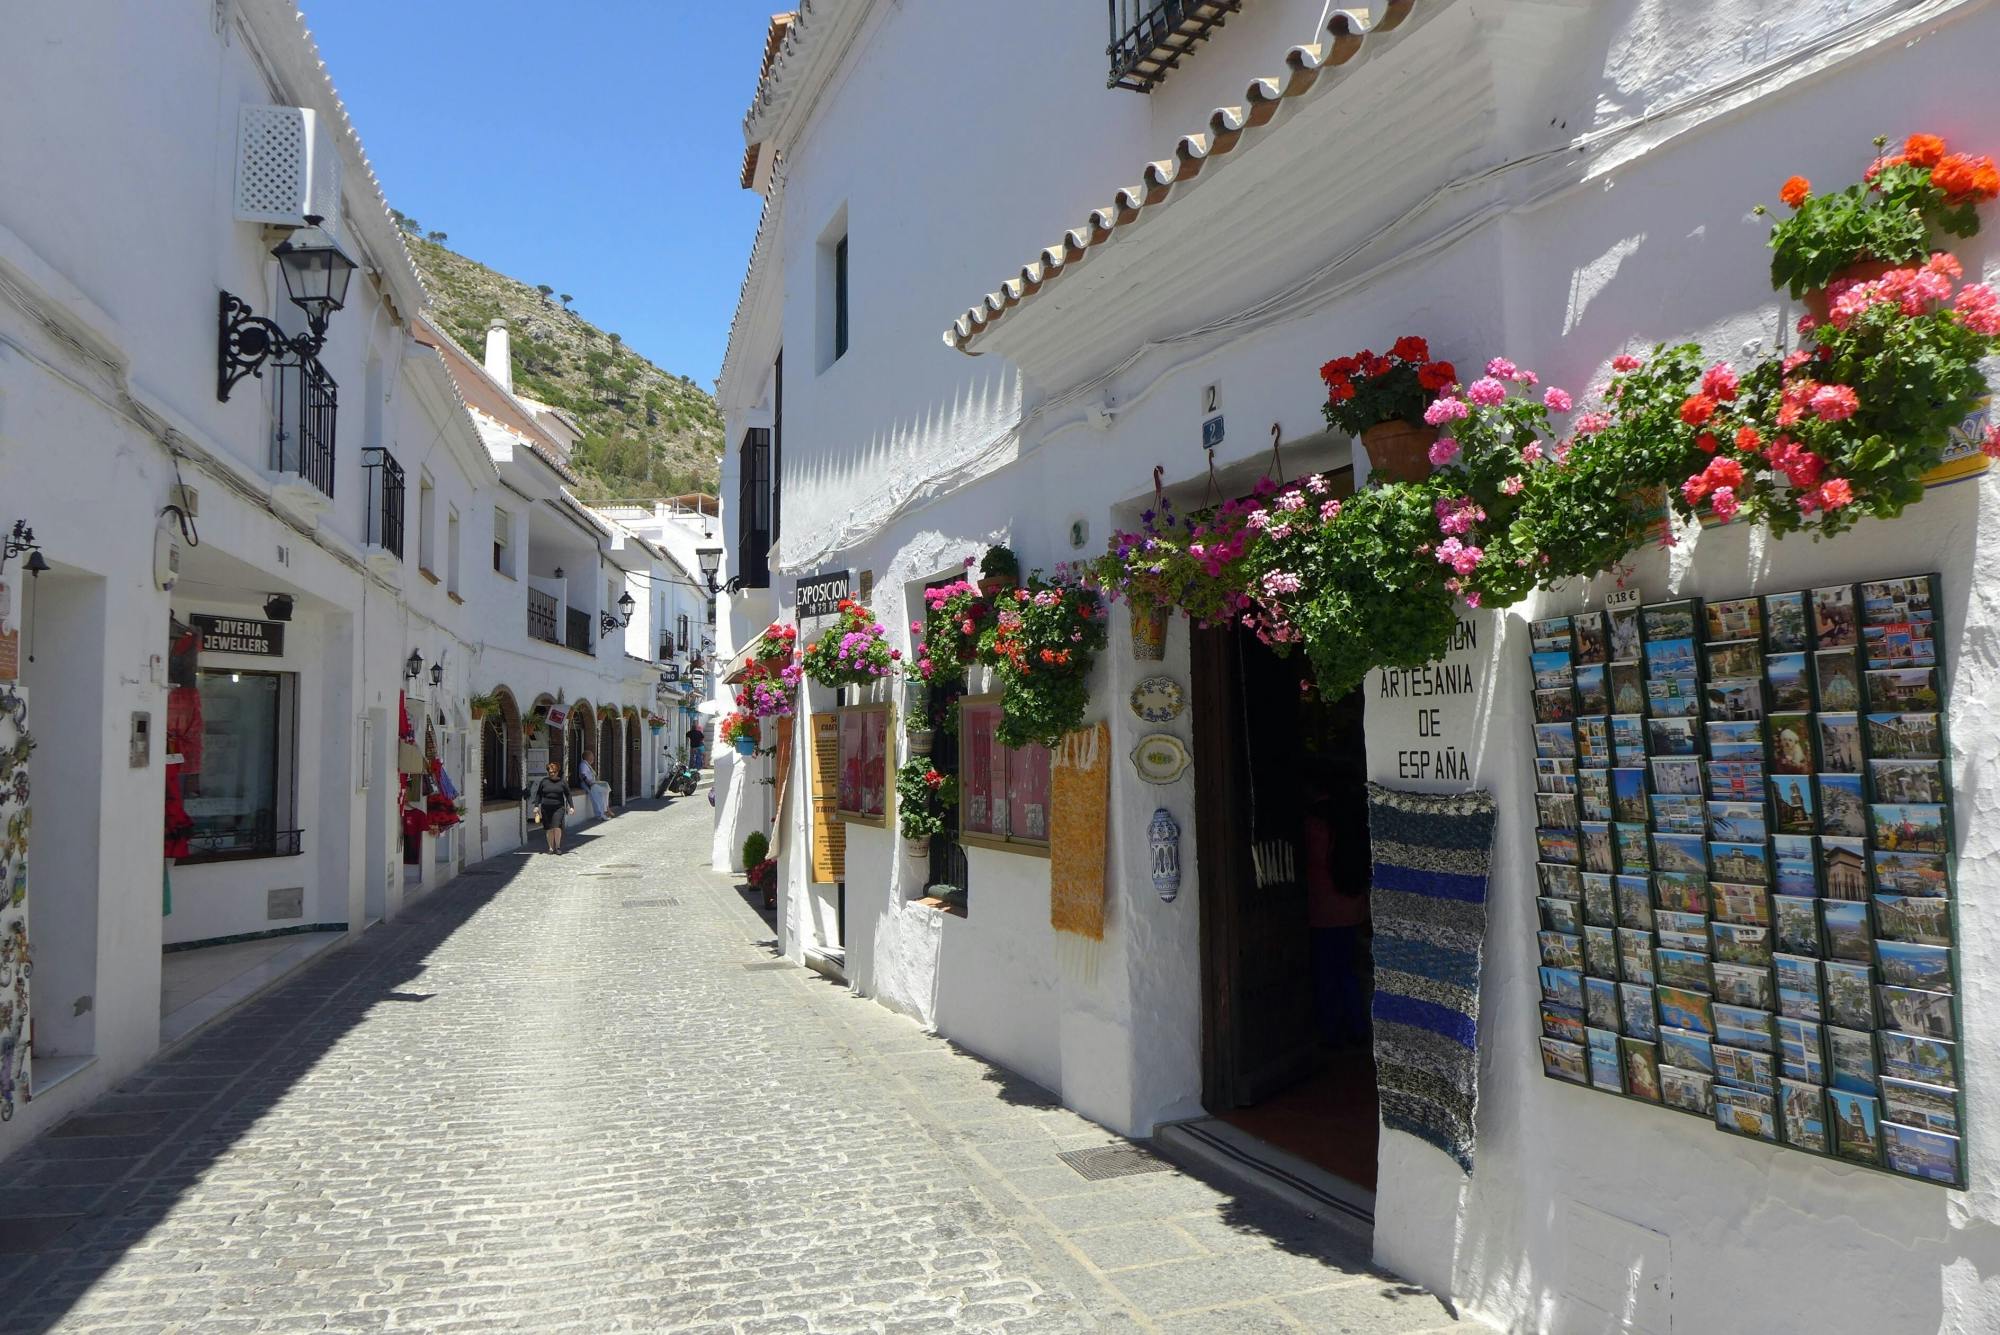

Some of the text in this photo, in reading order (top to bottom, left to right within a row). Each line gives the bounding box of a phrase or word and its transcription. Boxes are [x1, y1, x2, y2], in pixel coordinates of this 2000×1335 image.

[1207, 385, 1217, 412] 2
[1209, 423, 1216, 440] 2
[797, 580, 848, 606] EXPOSICION
[1607, 590, 1637, 605] 0,18 €
[214, 620, 263, 637] JOYERIA
[203, 635, 269, 653] JEWELLERS
[1380, 664, 1474, 698] ARTESANIA
[1418, 708, 1441, 737] DE
[1399, 746, 1470, 780] ESPAÑA
